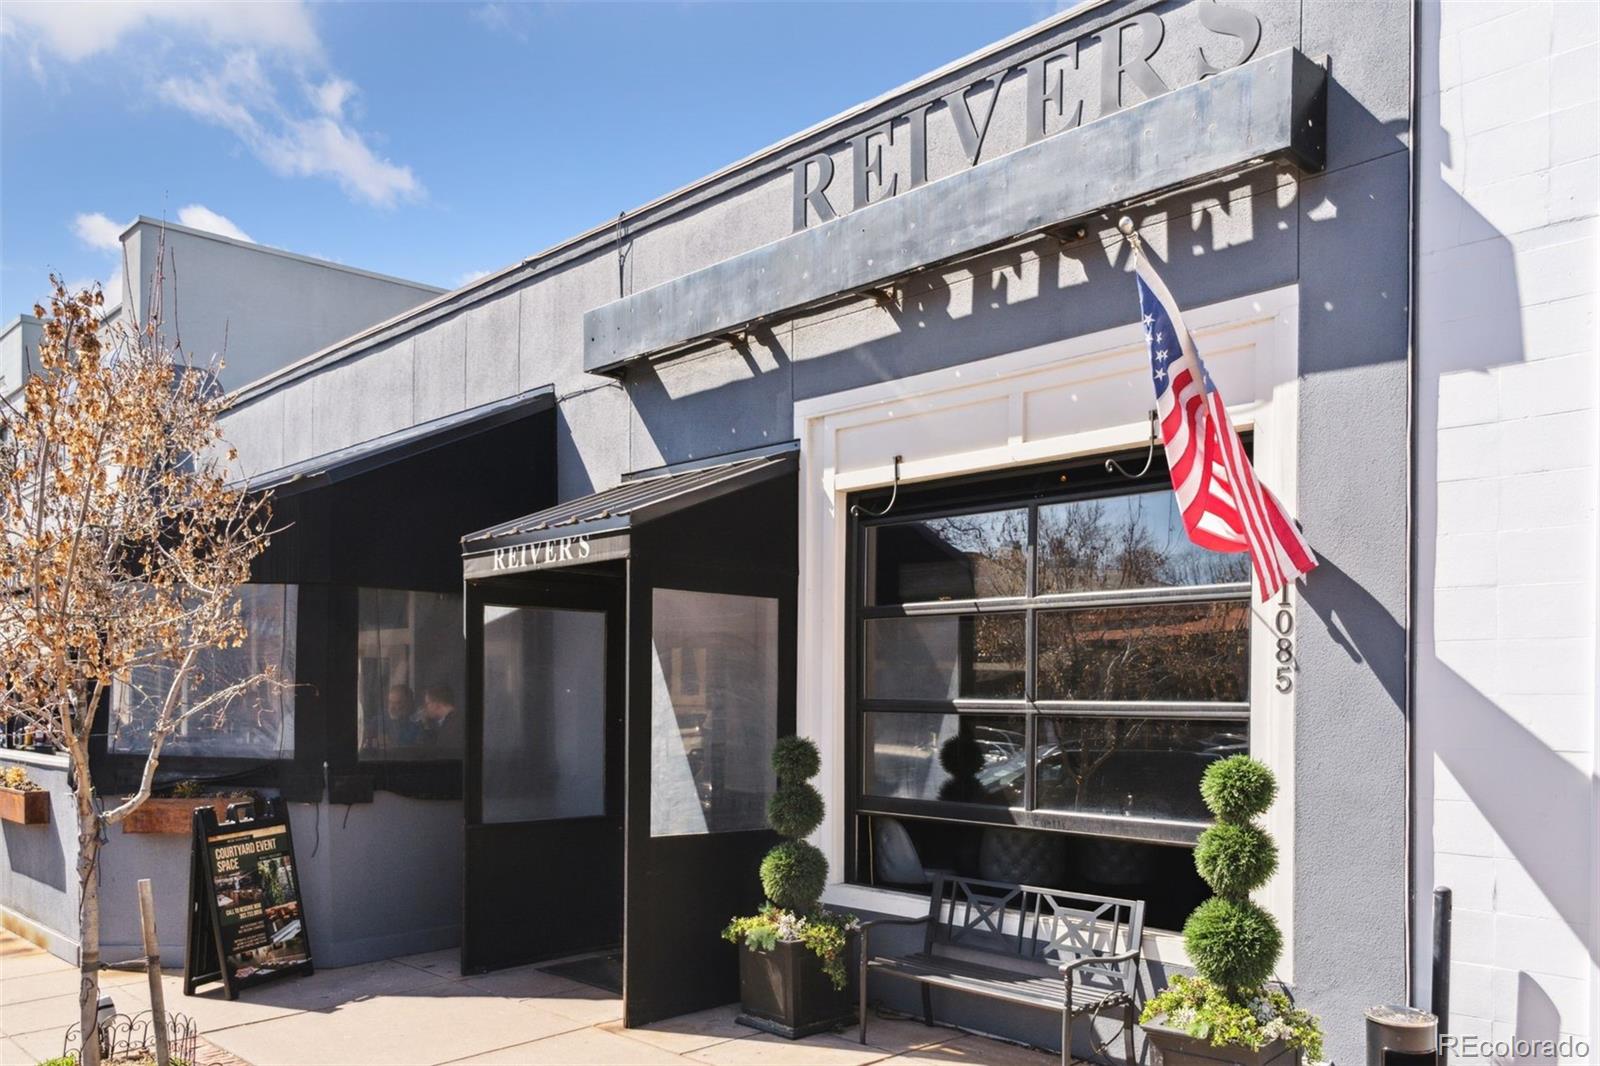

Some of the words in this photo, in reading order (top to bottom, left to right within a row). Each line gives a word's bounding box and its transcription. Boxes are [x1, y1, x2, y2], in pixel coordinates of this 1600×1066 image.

[1275, 584, 1294, 694] 1085
[215, 842, 256, 859] COURTYARD
[256, 838, 276, 852] EVENT
[217, 858, 239, 872] SPACE
